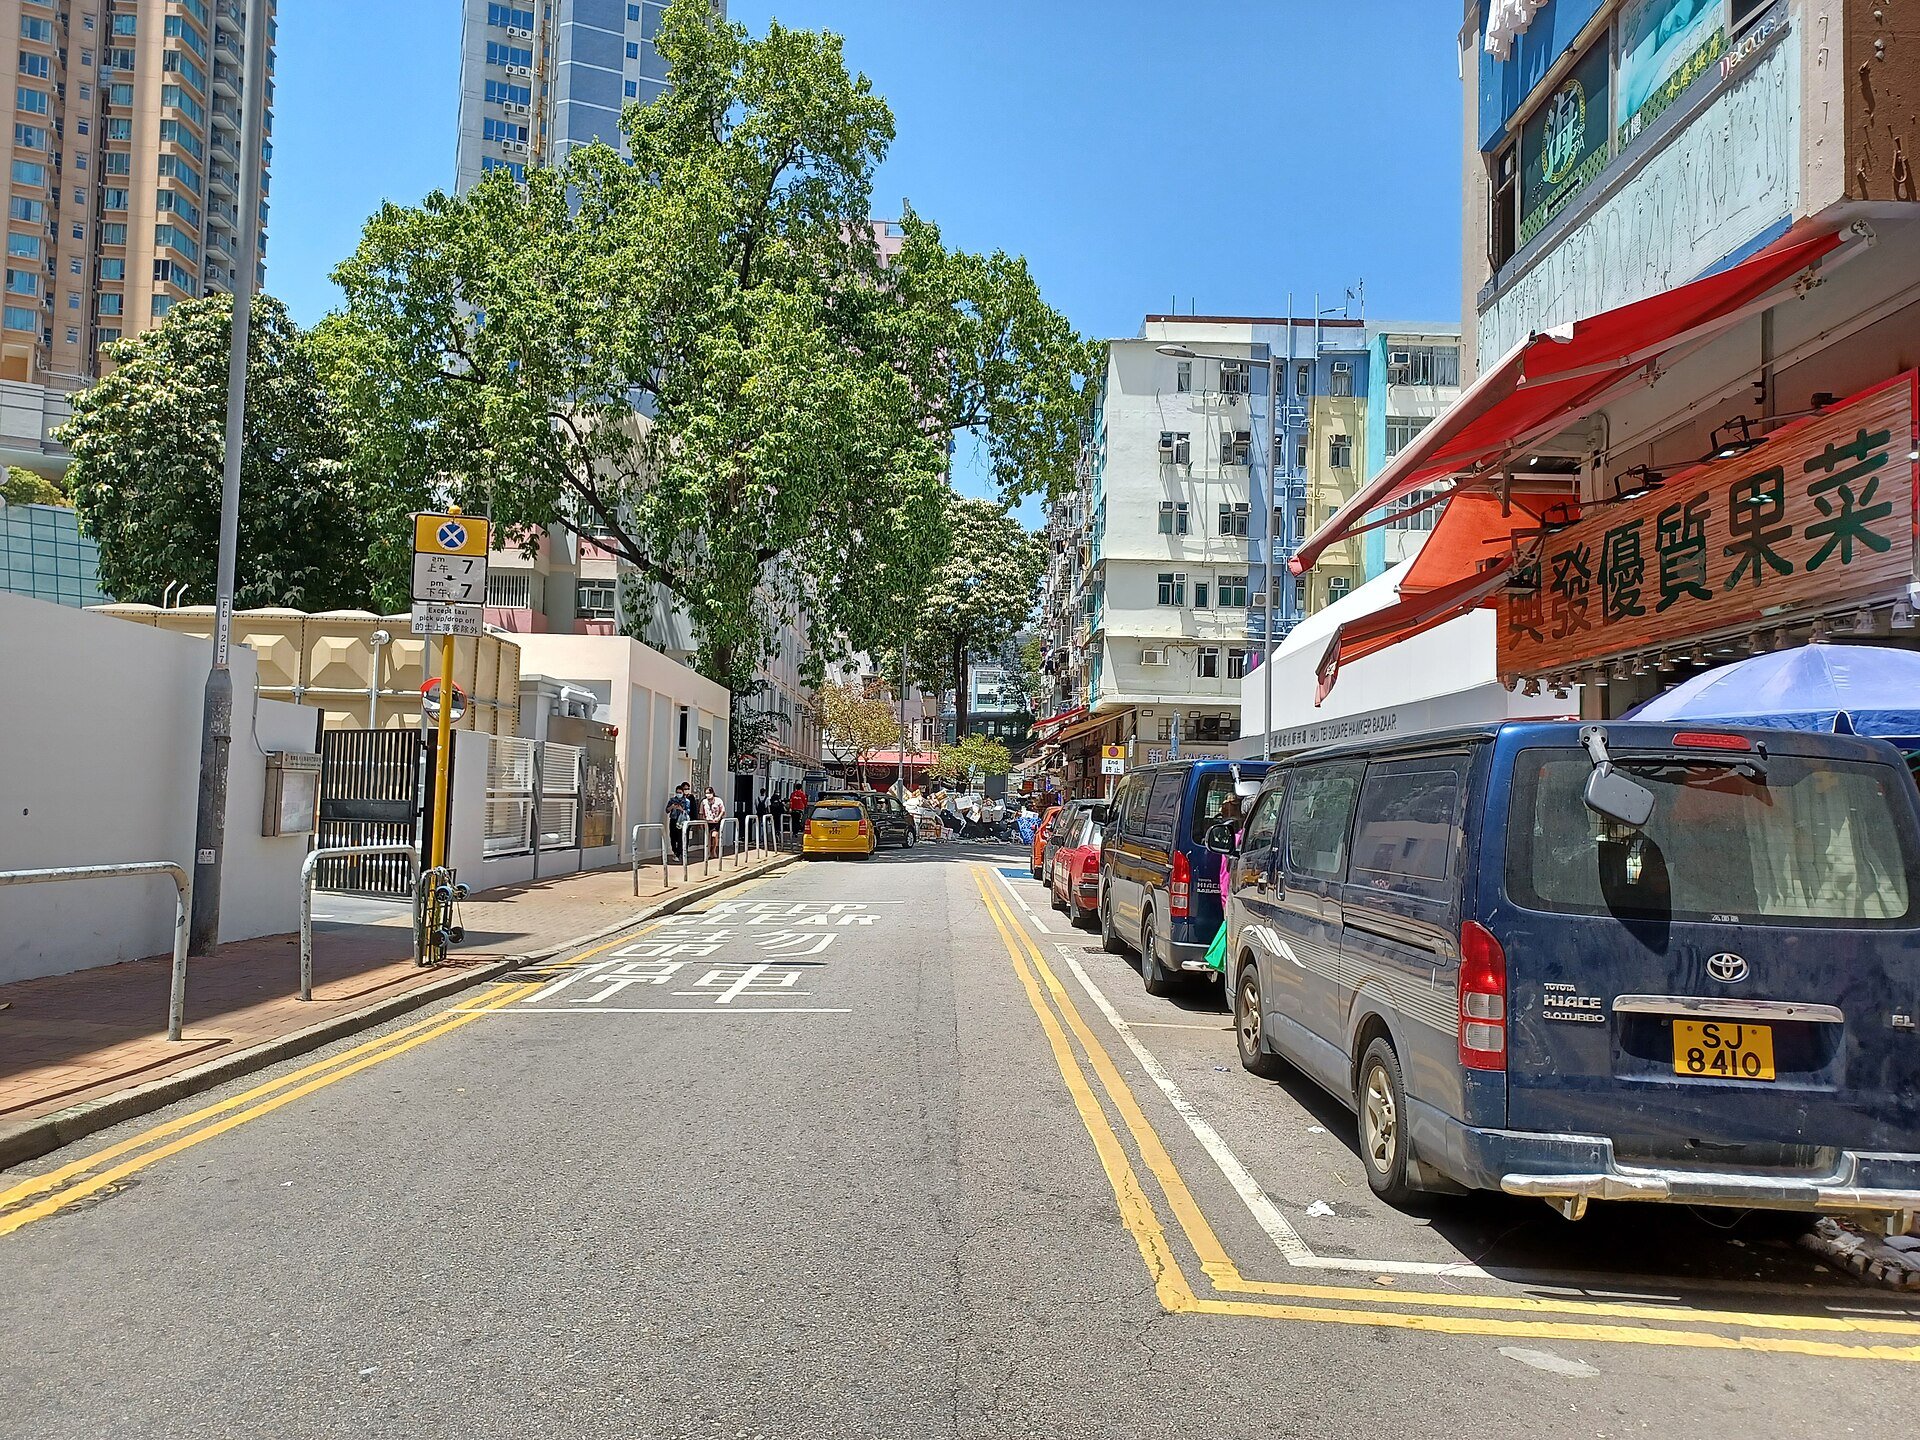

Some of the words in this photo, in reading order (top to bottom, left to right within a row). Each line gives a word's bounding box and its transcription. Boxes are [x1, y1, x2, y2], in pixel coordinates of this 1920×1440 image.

[427, 563, 449, 574] 上午
[462, 560, 474, 574] 7
[426, 587, 448, 598] 下午
[460, 583, 473, 598] 7
[222, 601, 228, 618] FC
[428, 607, 452, 615] Except
[454, 608, 468, 616] taxi
[435, 616, 464, 624] up/drop
[415, 622, 478, 634] 的士上落客除外
[219, 624, 227, 664] 0257
[1328, 722, 1348, 739] SQUARE
[1372, 713, 1397, 733] BAZAAR
[704, 902, 870, 915] KEEP
[668, 913, 883, 927] CLEAR
[608, 929, 840, 958] 請勿
[521, 957, 815, 1004] 停車
[1543, 982, 1576, 992] TOYOTA
[1543, 994, 1602, 1009] HIACE
[1702, 1024, 1742, 1050] SJ
[1687, 1047, 1762, 1077] 8410
